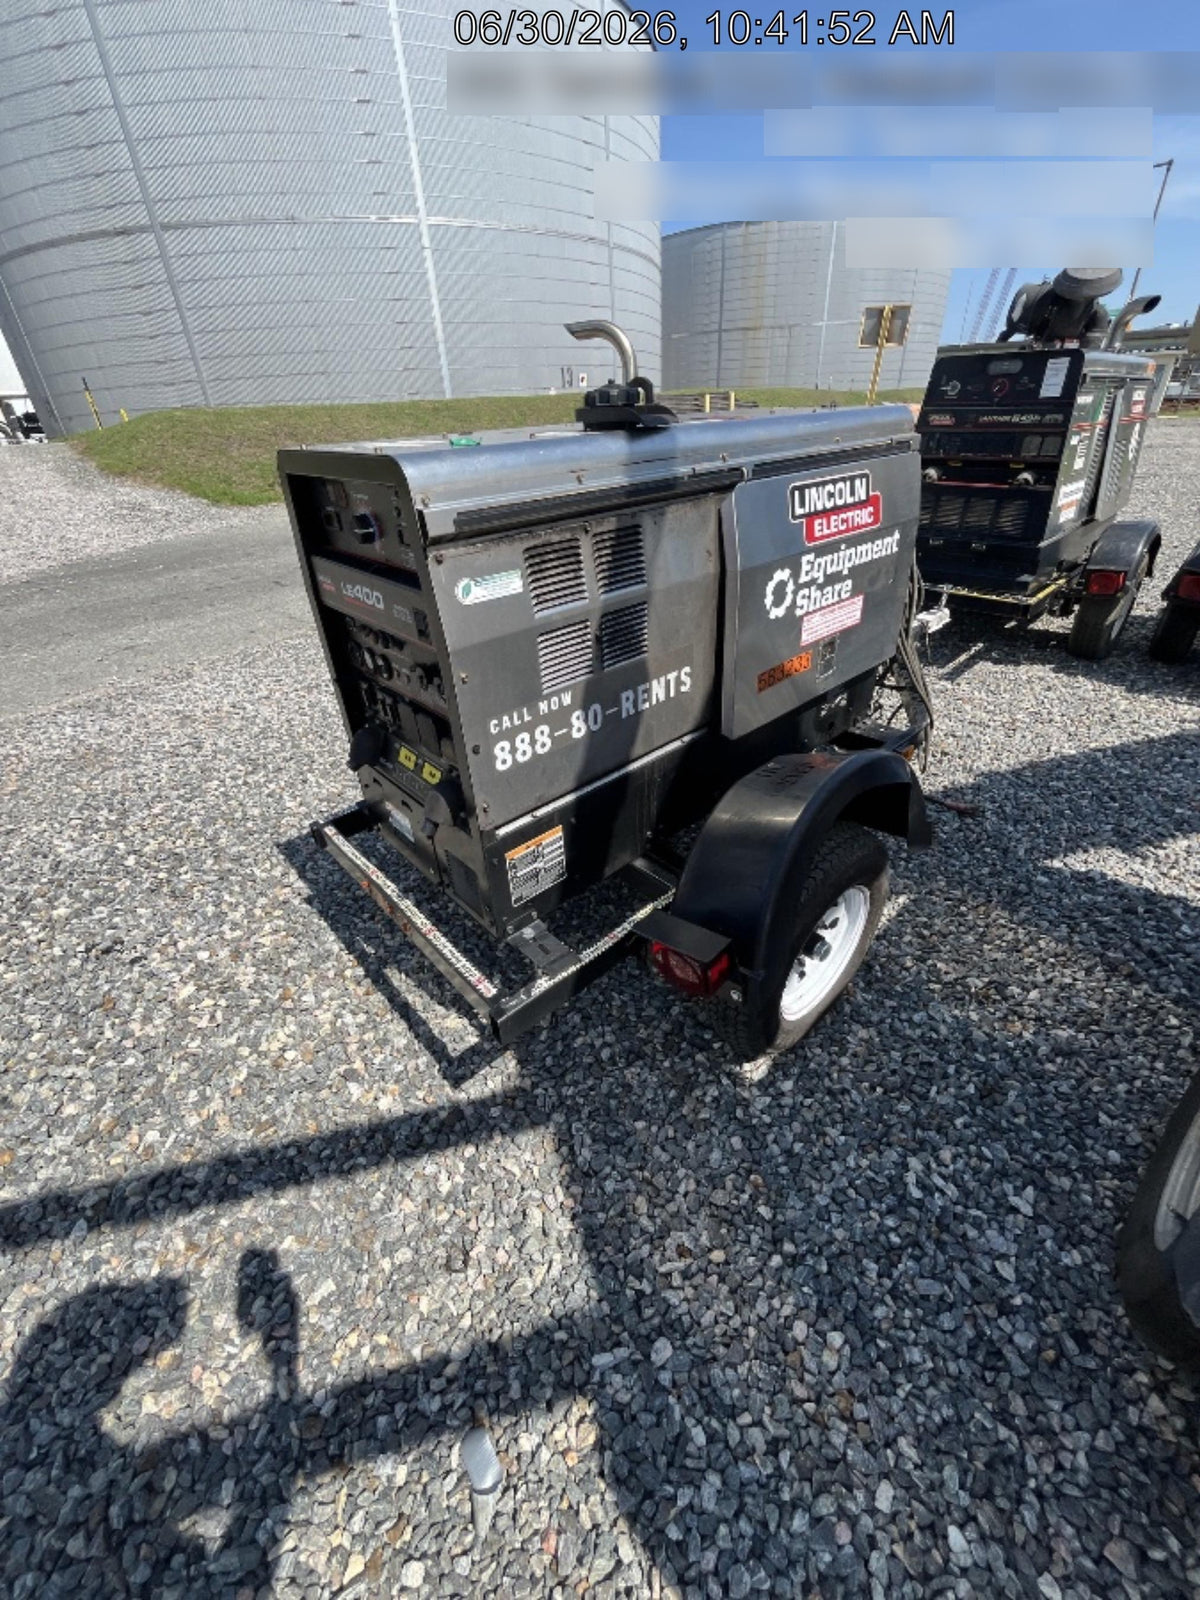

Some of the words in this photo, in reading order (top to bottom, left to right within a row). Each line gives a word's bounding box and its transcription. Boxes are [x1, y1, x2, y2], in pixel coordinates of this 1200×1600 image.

[794, 478, 867, 516] LINCOLN
[814, 506, 874, 537] ELECTRIC
[798, 529, 900, 584] Equipment
[794, 579, 853, 617] Share
[489, 707, 533, 735] CALL
[539, 690, 573, 716] NOW
[493, 666, 692, 771] 888-80-RENTS
